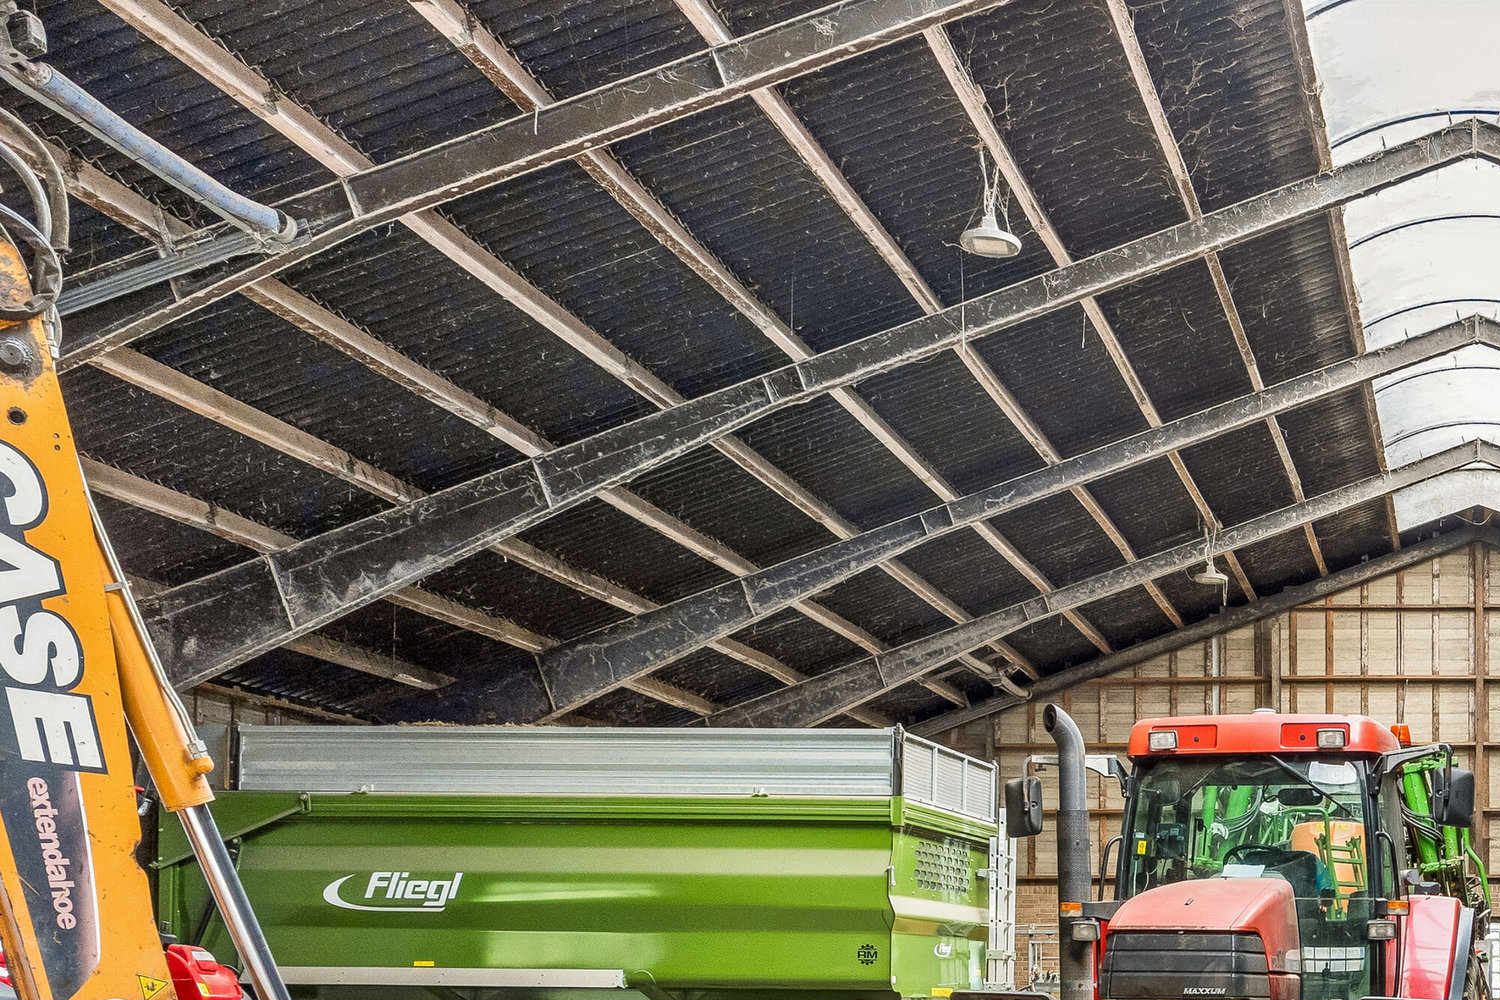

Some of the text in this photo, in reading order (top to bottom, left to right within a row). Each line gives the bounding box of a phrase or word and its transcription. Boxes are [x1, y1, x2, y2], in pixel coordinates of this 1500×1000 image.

[27, 777, 77, 930] extendahoe
[364, 871, 463, 907] Fliegl
[857, 950, 878, 959] RM
[1183, 987, 1227, 995] MAXXUM
